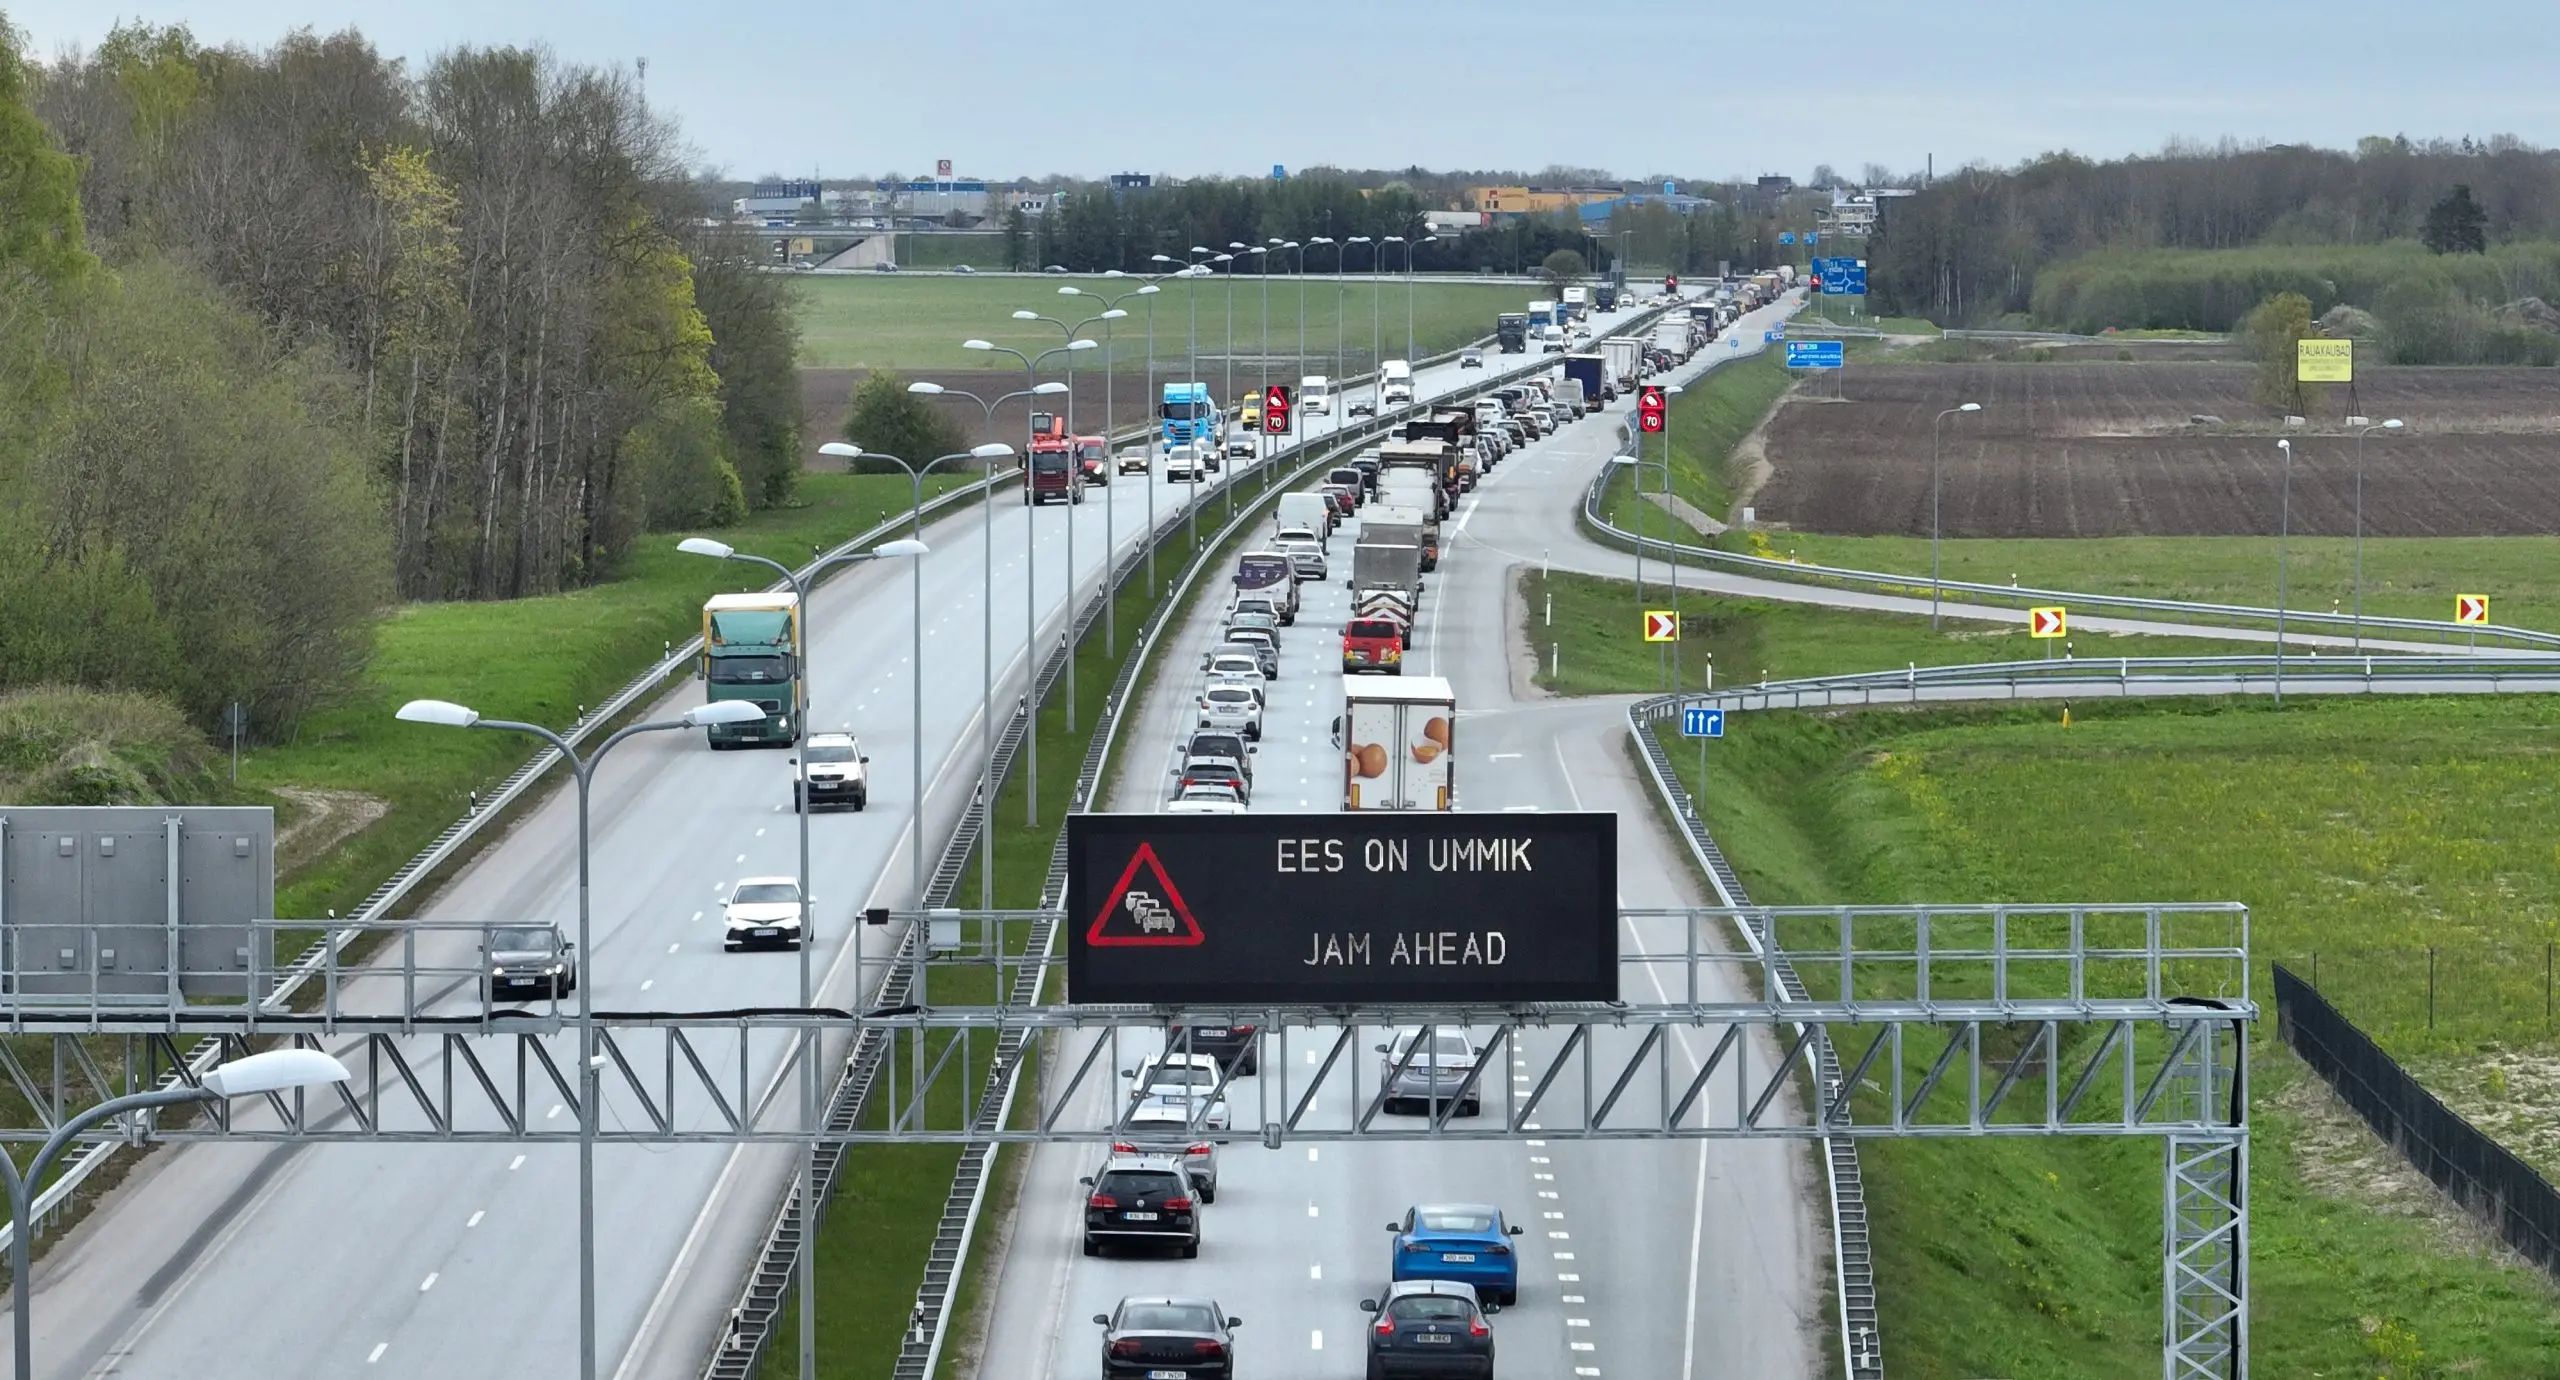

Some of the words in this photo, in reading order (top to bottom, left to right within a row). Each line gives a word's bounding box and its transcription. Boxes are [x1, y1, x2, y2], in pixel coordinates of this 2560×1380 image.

[1270, 417, 1282, 428] 70
[1646, 416, 1658, 427] 70
[1278, 838, 1344, 872] EES
[1365, 838, 1408, 872] ON
[1429, 838, 1532, 872] UMMIK
[1304, 932, 1370, 966] JAM
[1390, 932, 1506, 966] AHEAD
